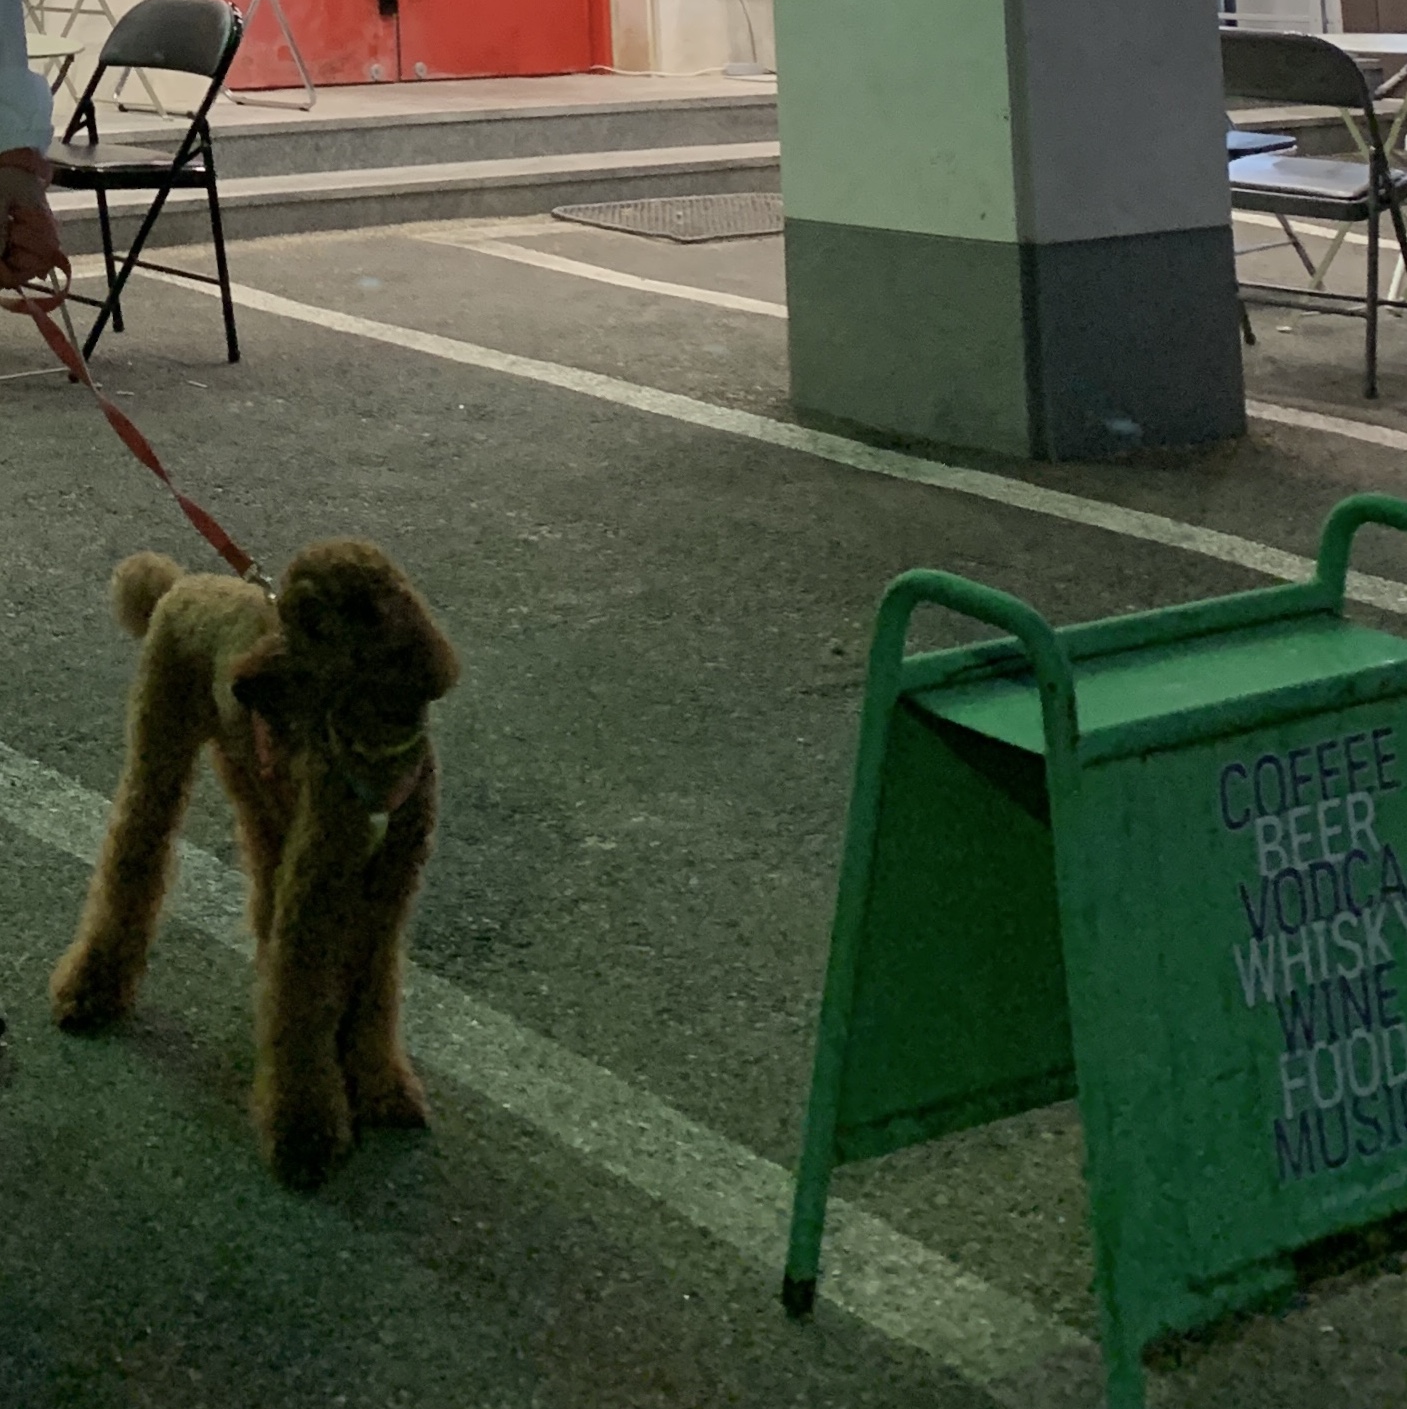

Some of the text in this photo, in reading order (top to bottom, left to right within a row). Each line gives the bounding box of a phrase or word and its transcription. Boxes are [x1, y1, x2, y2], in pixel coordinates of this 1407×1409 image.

[1220, 727, 1402, 829] COFFEE
[1254, 791, 1381, 877] BEER
[1239, 844, 1407, 941] VODCA
[1275, 960, 1404, 1052] WINE
[1273, 1082, 1407, 1180] MUSI
